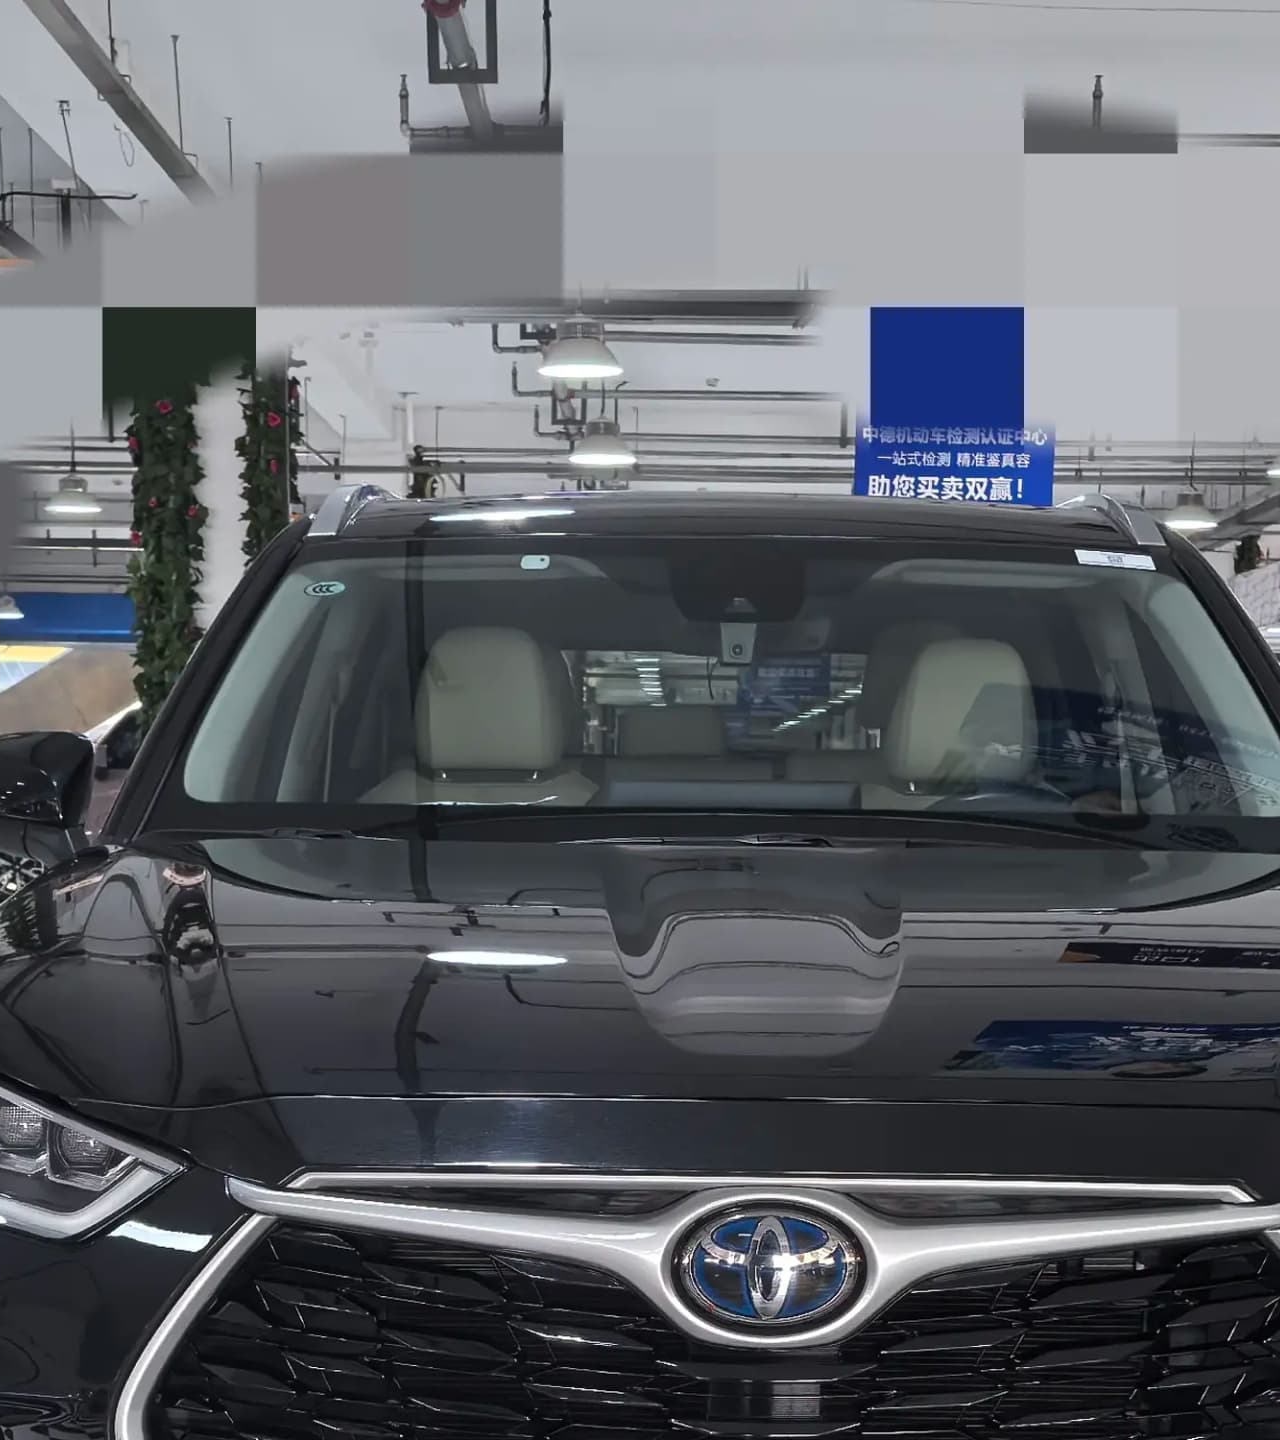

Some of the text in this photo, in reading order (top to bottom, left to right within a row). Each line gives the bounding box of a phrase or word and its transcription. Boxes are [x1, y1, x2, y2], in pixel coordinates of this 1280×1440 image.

[862, 425, 1048, 446] 中德机动车检测认证中心
[877, 451, 1032, 468] 一站式检测 精准鉴真容
[868, 475, 1024, 501] 助您买卖双赢！
